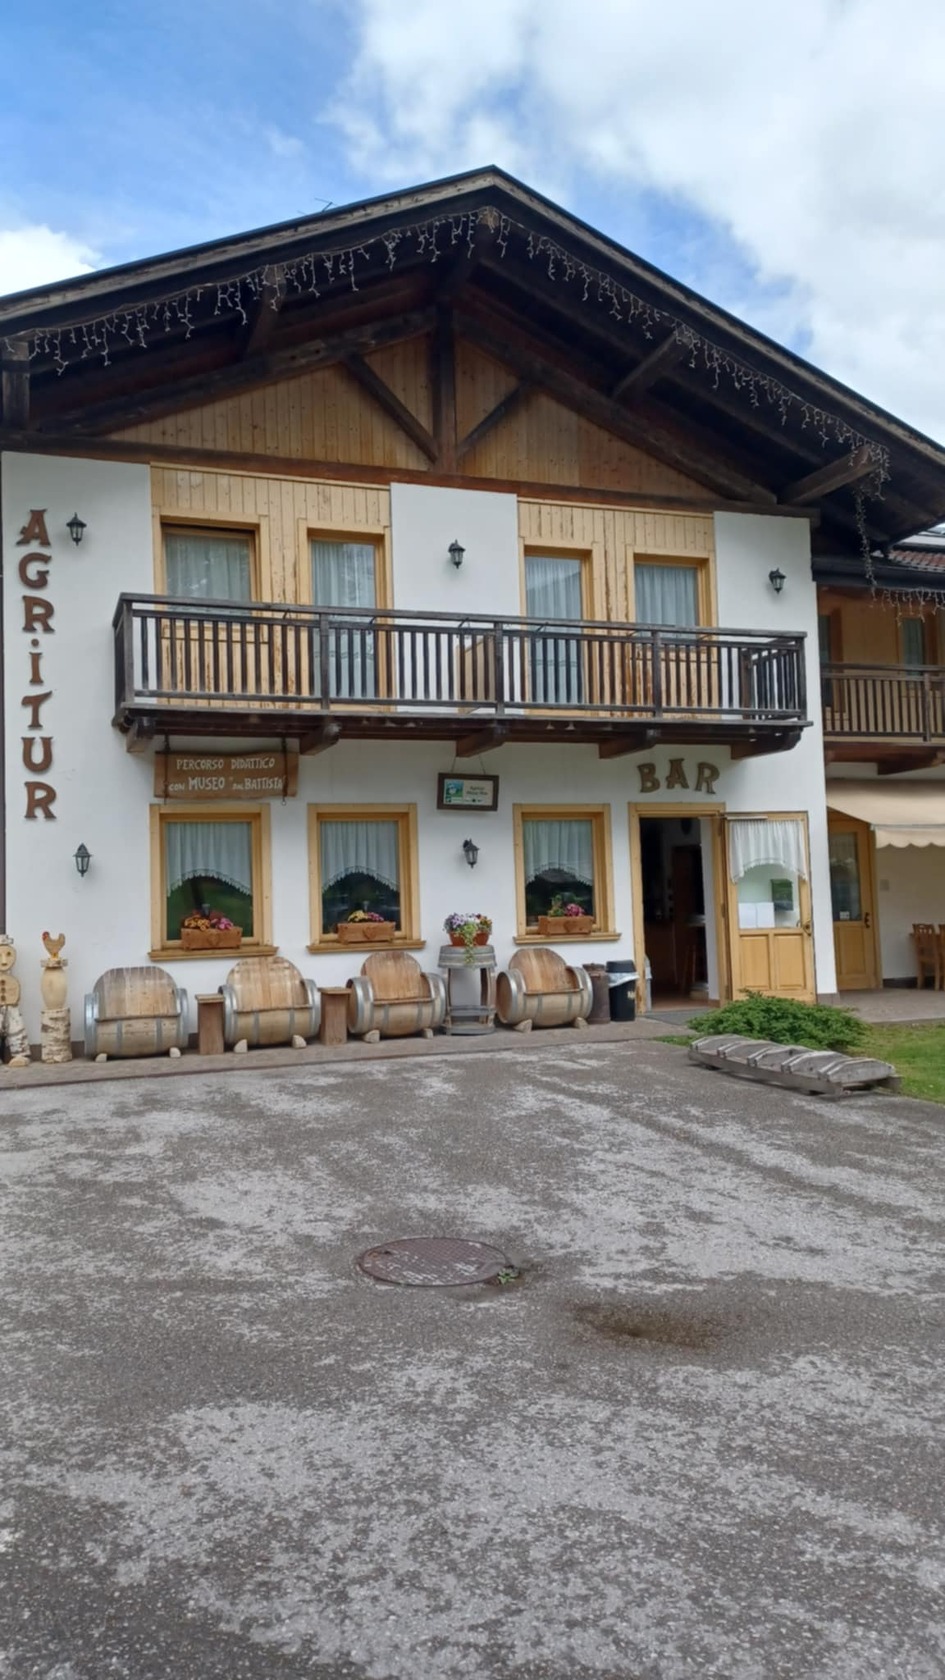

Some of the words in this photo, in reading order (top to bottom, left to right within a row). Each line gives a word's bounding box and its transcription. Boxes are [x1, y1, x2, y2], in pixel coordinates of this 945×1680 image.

[176, 759, 225, 770] PERCORSO
[231, 757, 276, 770] DIDATTICO
[188, 776, 225, 791] MUSEO
[637, 758, 720, 794] BAR
